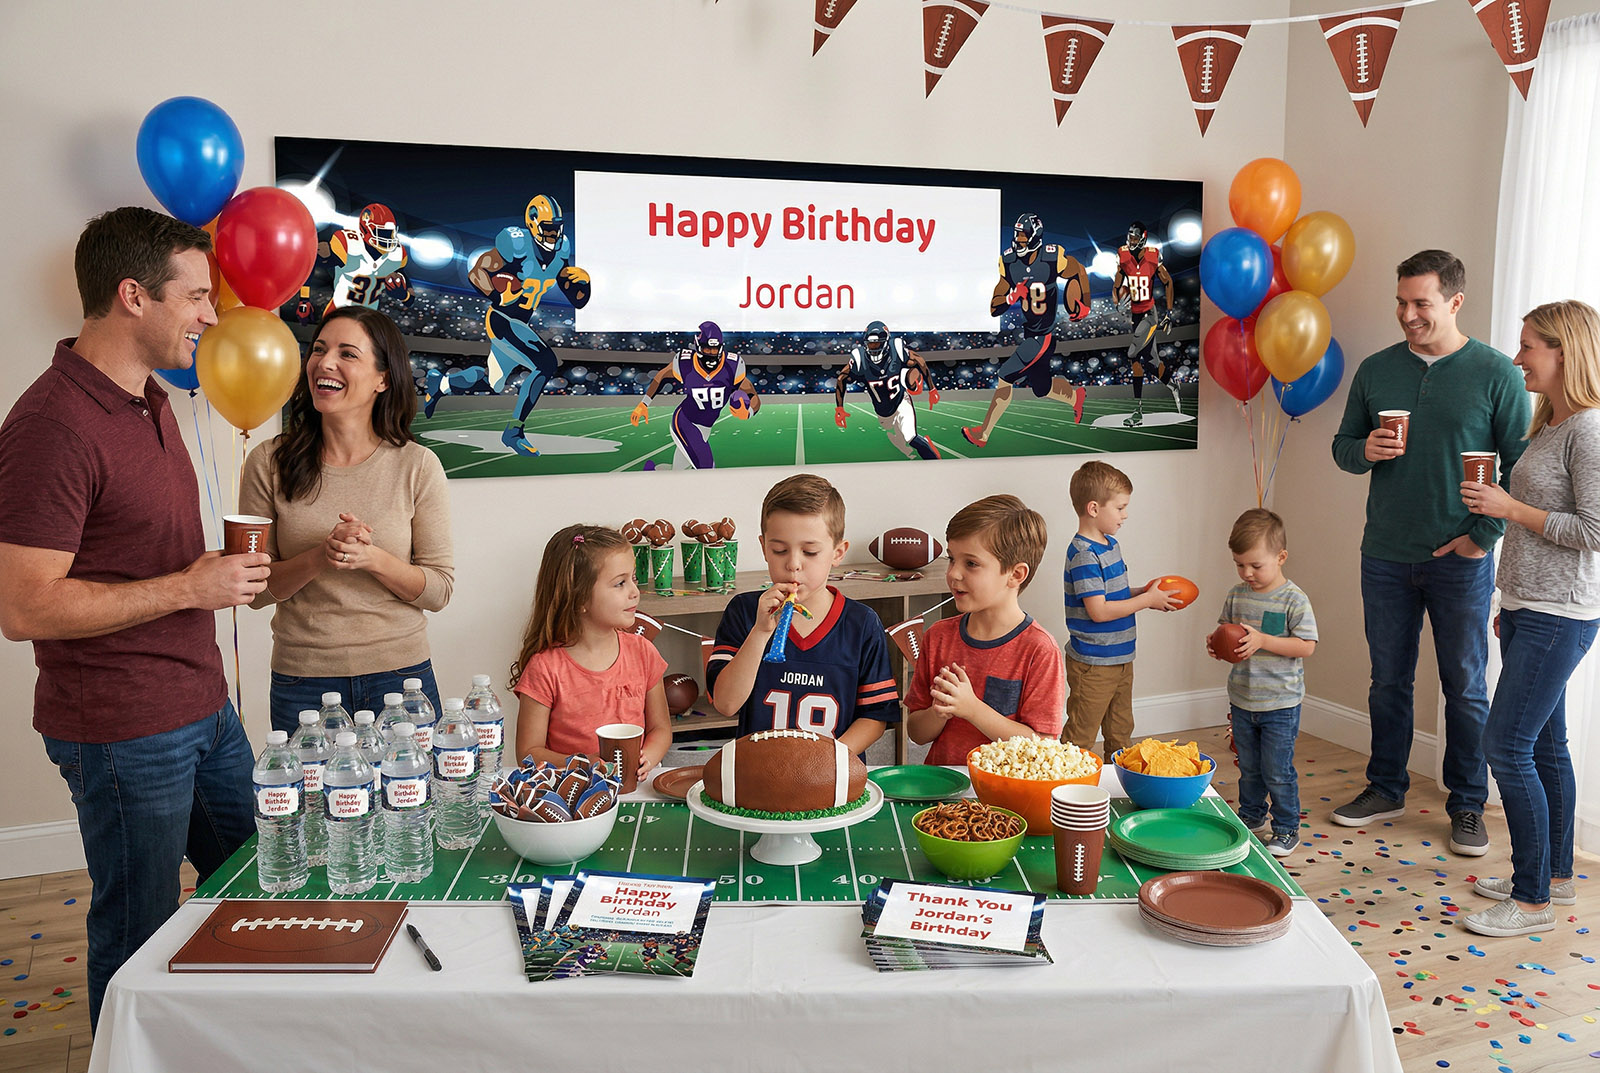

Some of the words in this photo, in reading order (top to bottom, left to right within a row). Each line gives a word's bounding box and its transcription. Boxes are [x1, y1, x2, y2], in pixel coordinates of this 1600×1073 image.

[648, 202, 772, 249] Happy
[781, 203, 936, 253] Birthday
[738, 275, 856, 310] Jordan
[1128, 275, 1151, 302] 88
[780, 671, 824, 687] JORDAN
[615, 887, 672, 900] Happy
[907, 891, 969, 908] Thank
[975, 898, 1013, 912] You
[600, 895, 677, 911] Birthday
[609, 906, 661, 917] Jordan
[915, 908, 993, 925] Jordan's
[910, 921, 992, 941] Birthday
